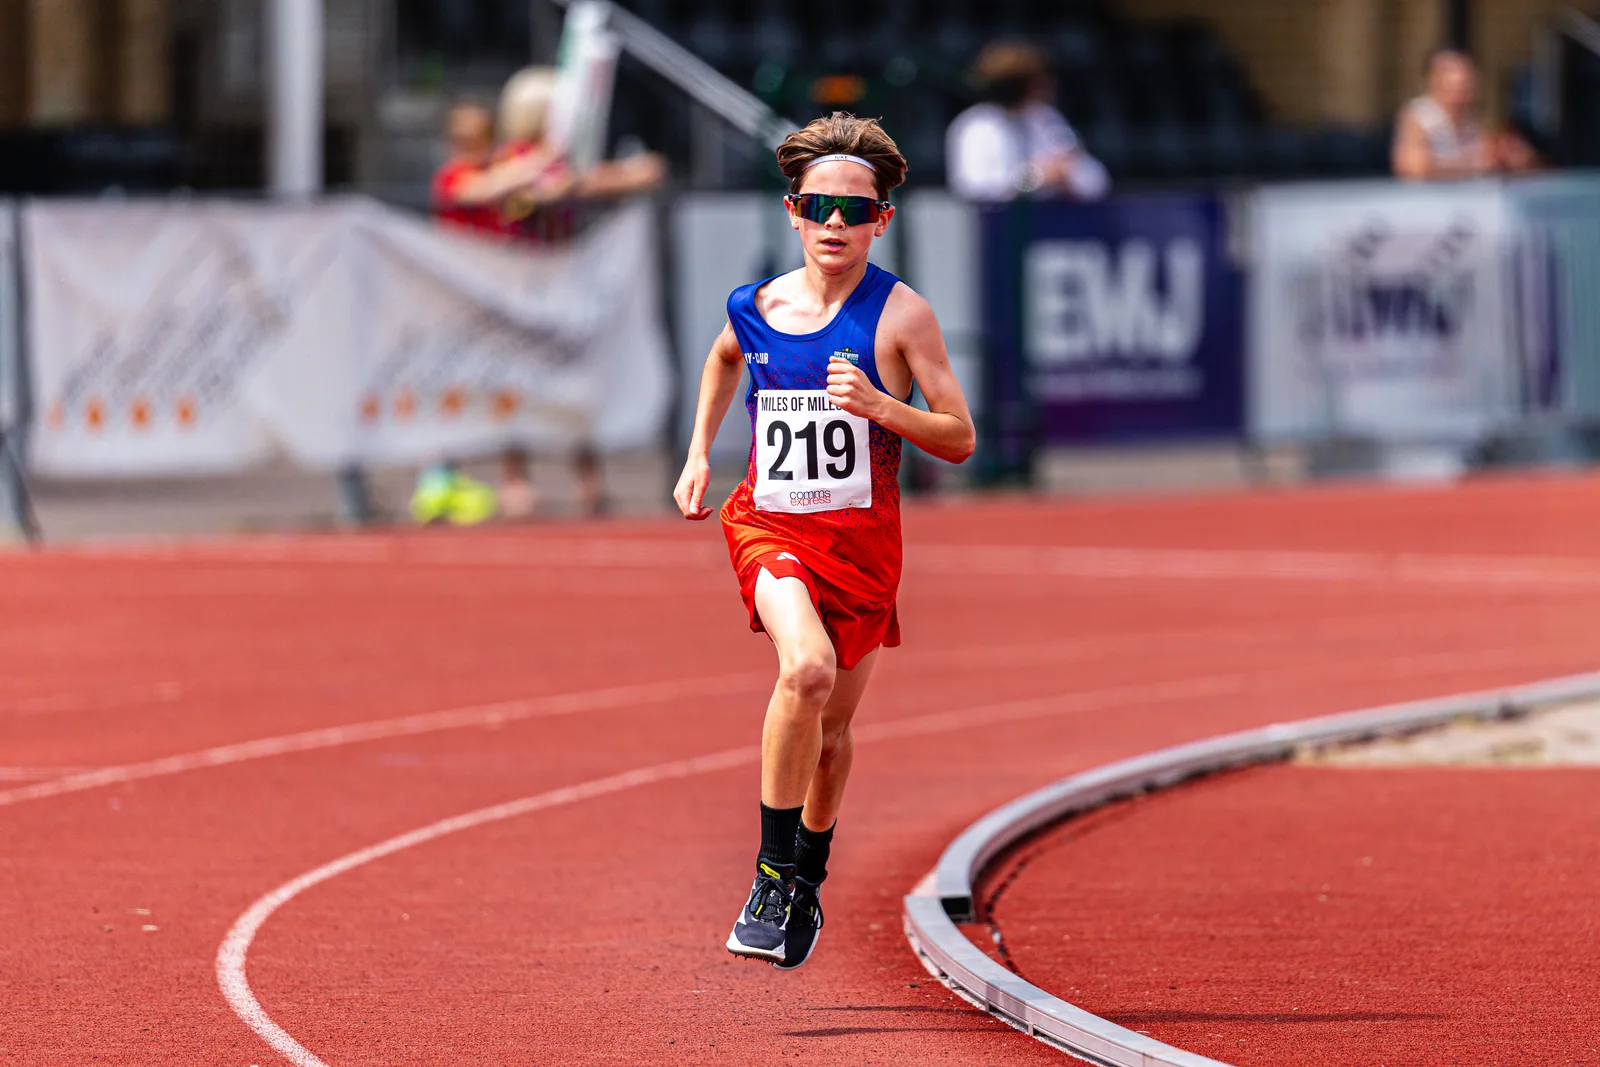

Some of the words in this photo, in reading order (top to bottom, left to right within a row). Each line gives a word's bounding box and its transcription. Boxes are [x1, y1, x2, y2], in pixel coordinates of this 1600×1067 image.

[761, 396, 788, 412] MILES
[791, 396, 804, 411] OF
[807, 396, 843, 412] MILE
[766, 419, 856, 481] 219
[789, 489, 831, 500] comms
[790, 496, 831, 507] express
